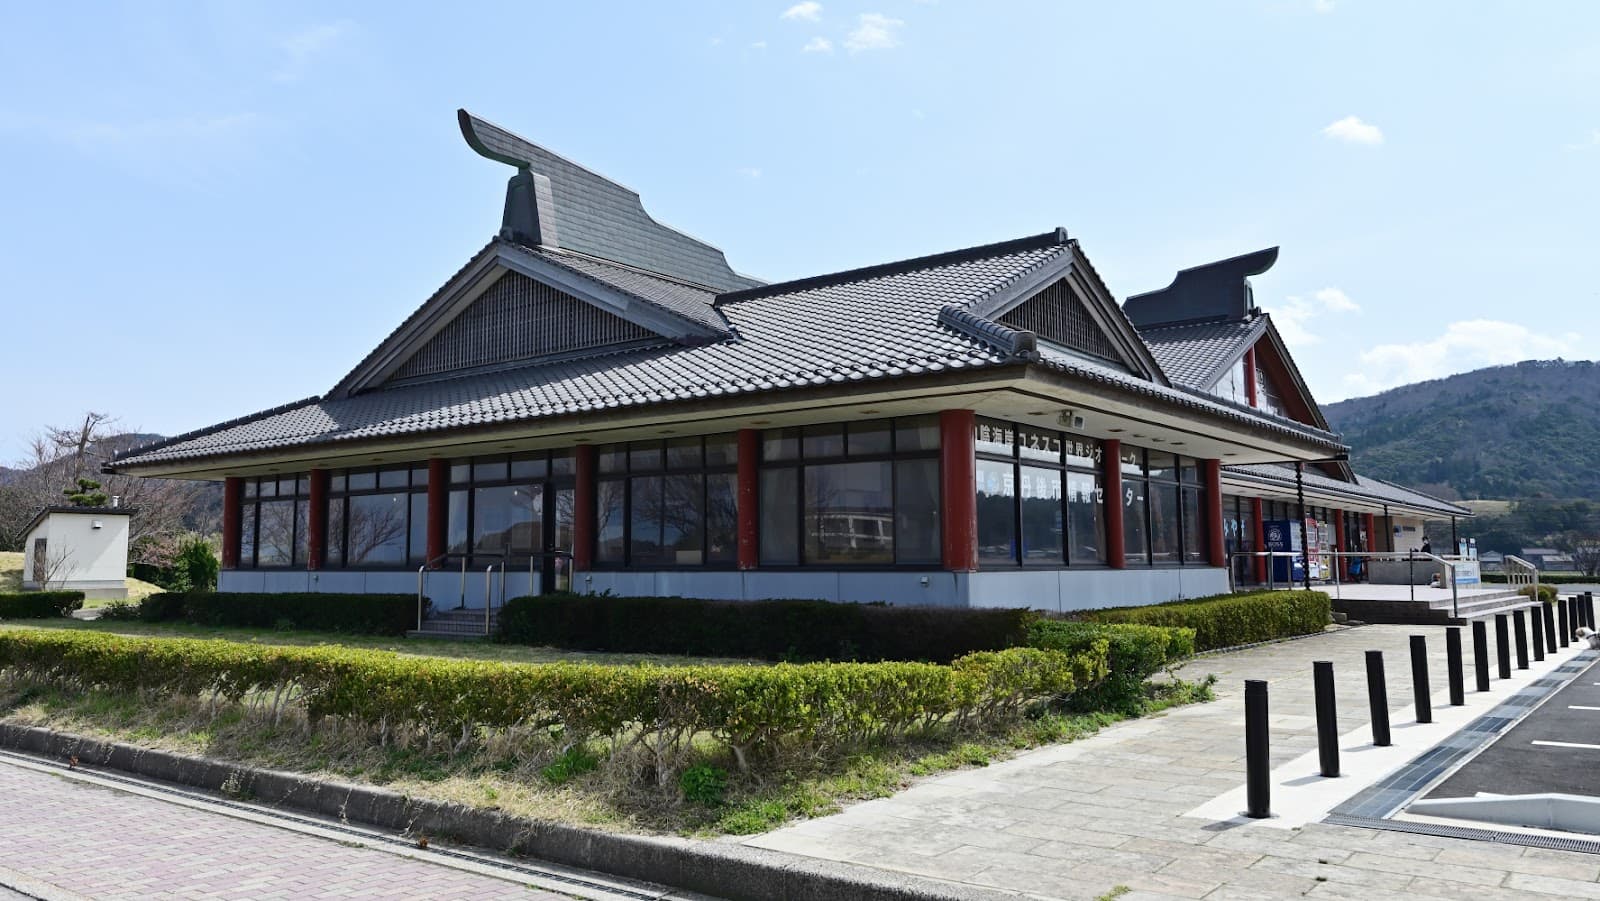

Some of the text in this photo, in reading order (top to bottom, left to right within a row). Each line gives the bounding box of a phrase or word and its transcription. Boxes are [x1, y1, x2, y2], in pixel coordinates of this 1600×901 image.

[974, 424, 1137, 465] 陰海岸ユネスコ世界ジオーク
